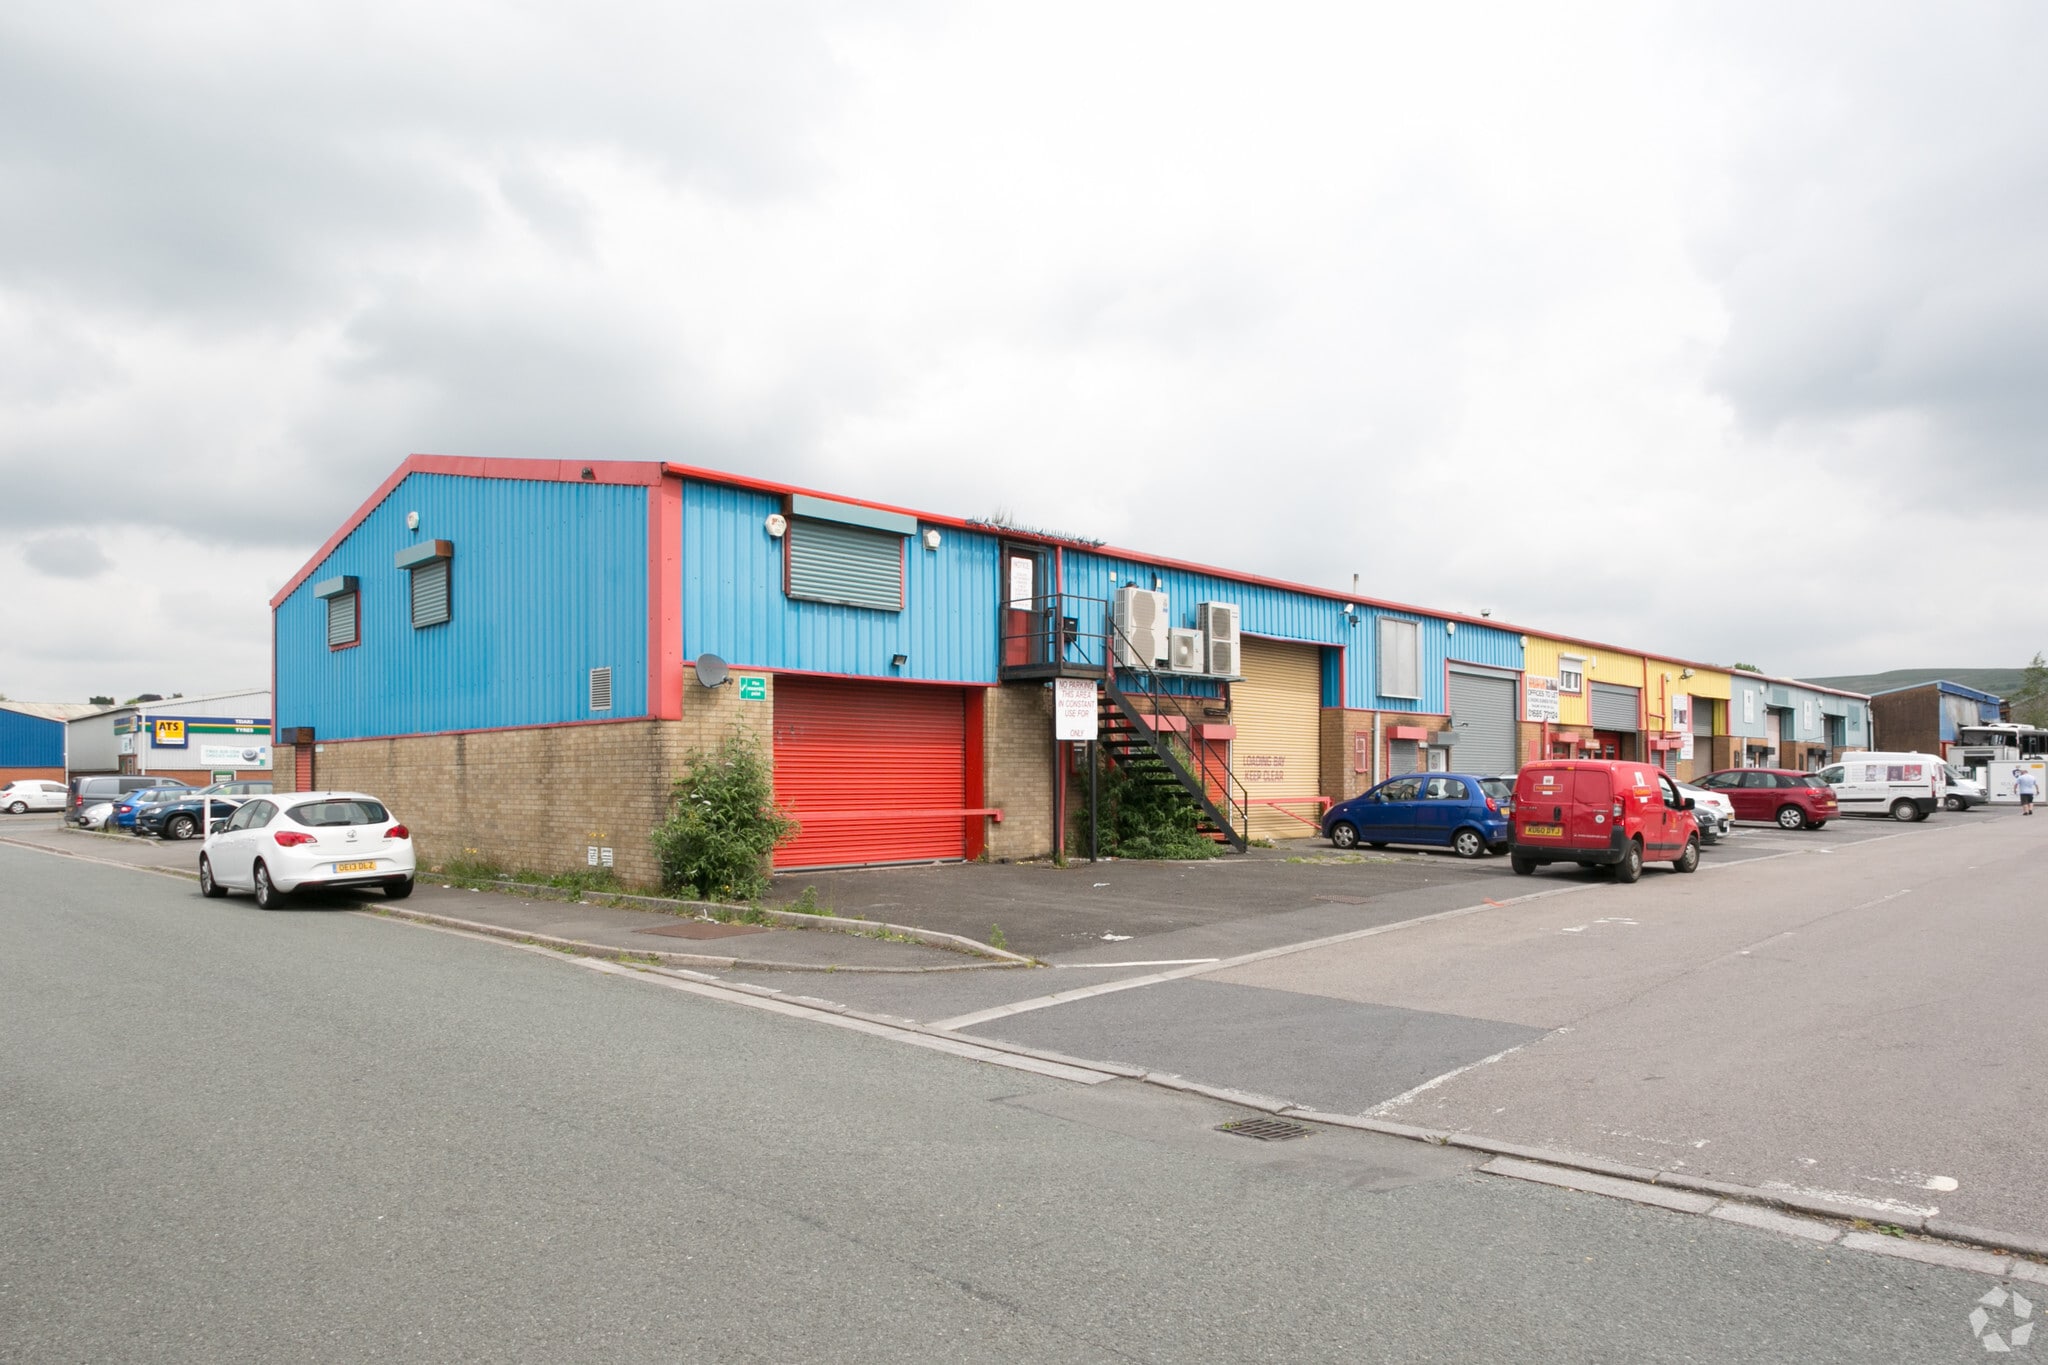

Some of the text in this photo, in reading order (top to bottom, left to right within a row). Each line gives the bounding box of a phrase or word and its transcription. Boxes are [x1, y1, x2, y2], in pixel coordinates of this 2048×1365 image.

[1058, 680, 1094, 690] NO PARKING
[1062, 690, 1091, 699] THIS AREA
[1528, 689, 1544, 697] OFFICES
[1058, 700, 1095, 709] IN CONSTANT
[1064, 709, 1090, 718] USE FOR
[159, 721, 179, 731] ATS
[1069, 729, 1085, 738] ONLY
[1243, 755, 1286, 767] LOADING BAY
[1244, 769, 1284, 782] KEEP CLEAR
[338, 862, 357, 871] OE13
